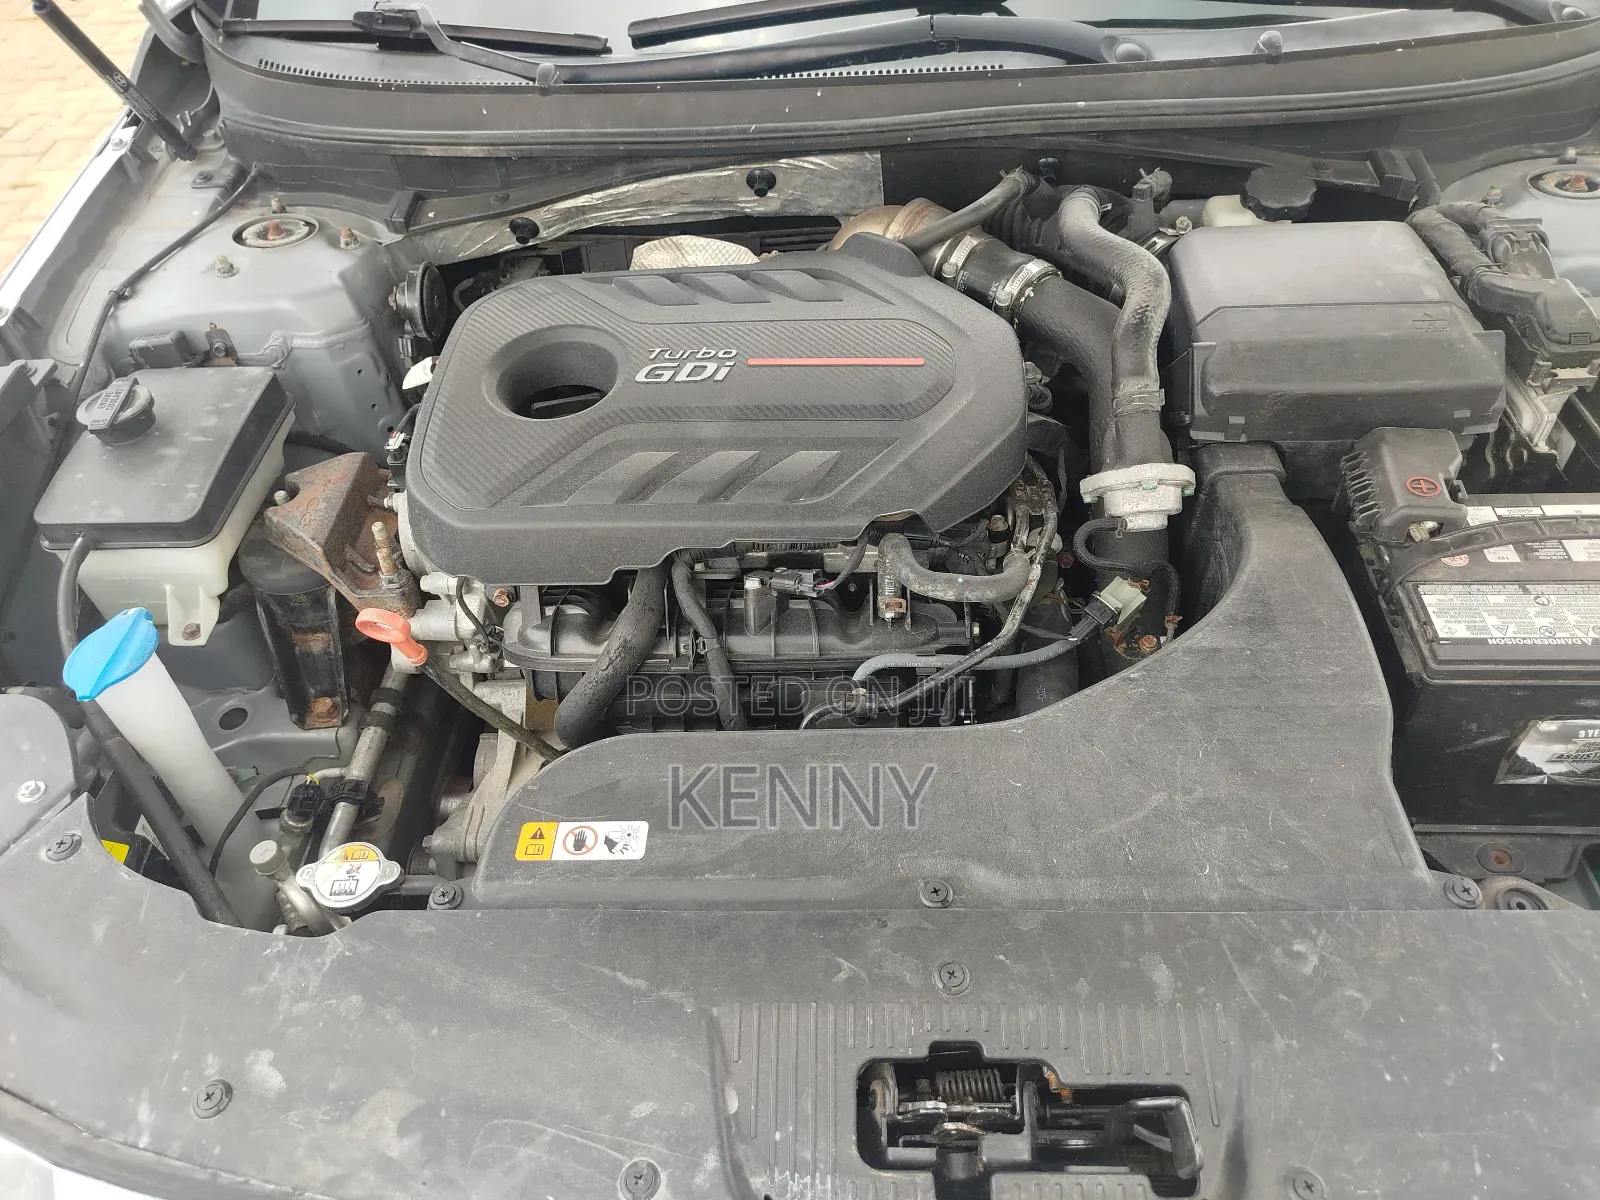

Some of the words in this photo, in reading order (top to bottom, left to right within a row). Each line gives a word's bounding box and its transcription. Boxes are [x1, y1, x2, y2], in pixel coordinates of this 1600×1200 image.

[648, 347, 738, 360] Turbo
[634, 361, 737, 382] GDi
[1487, 637, 1582, 645] DANGER/POISON
